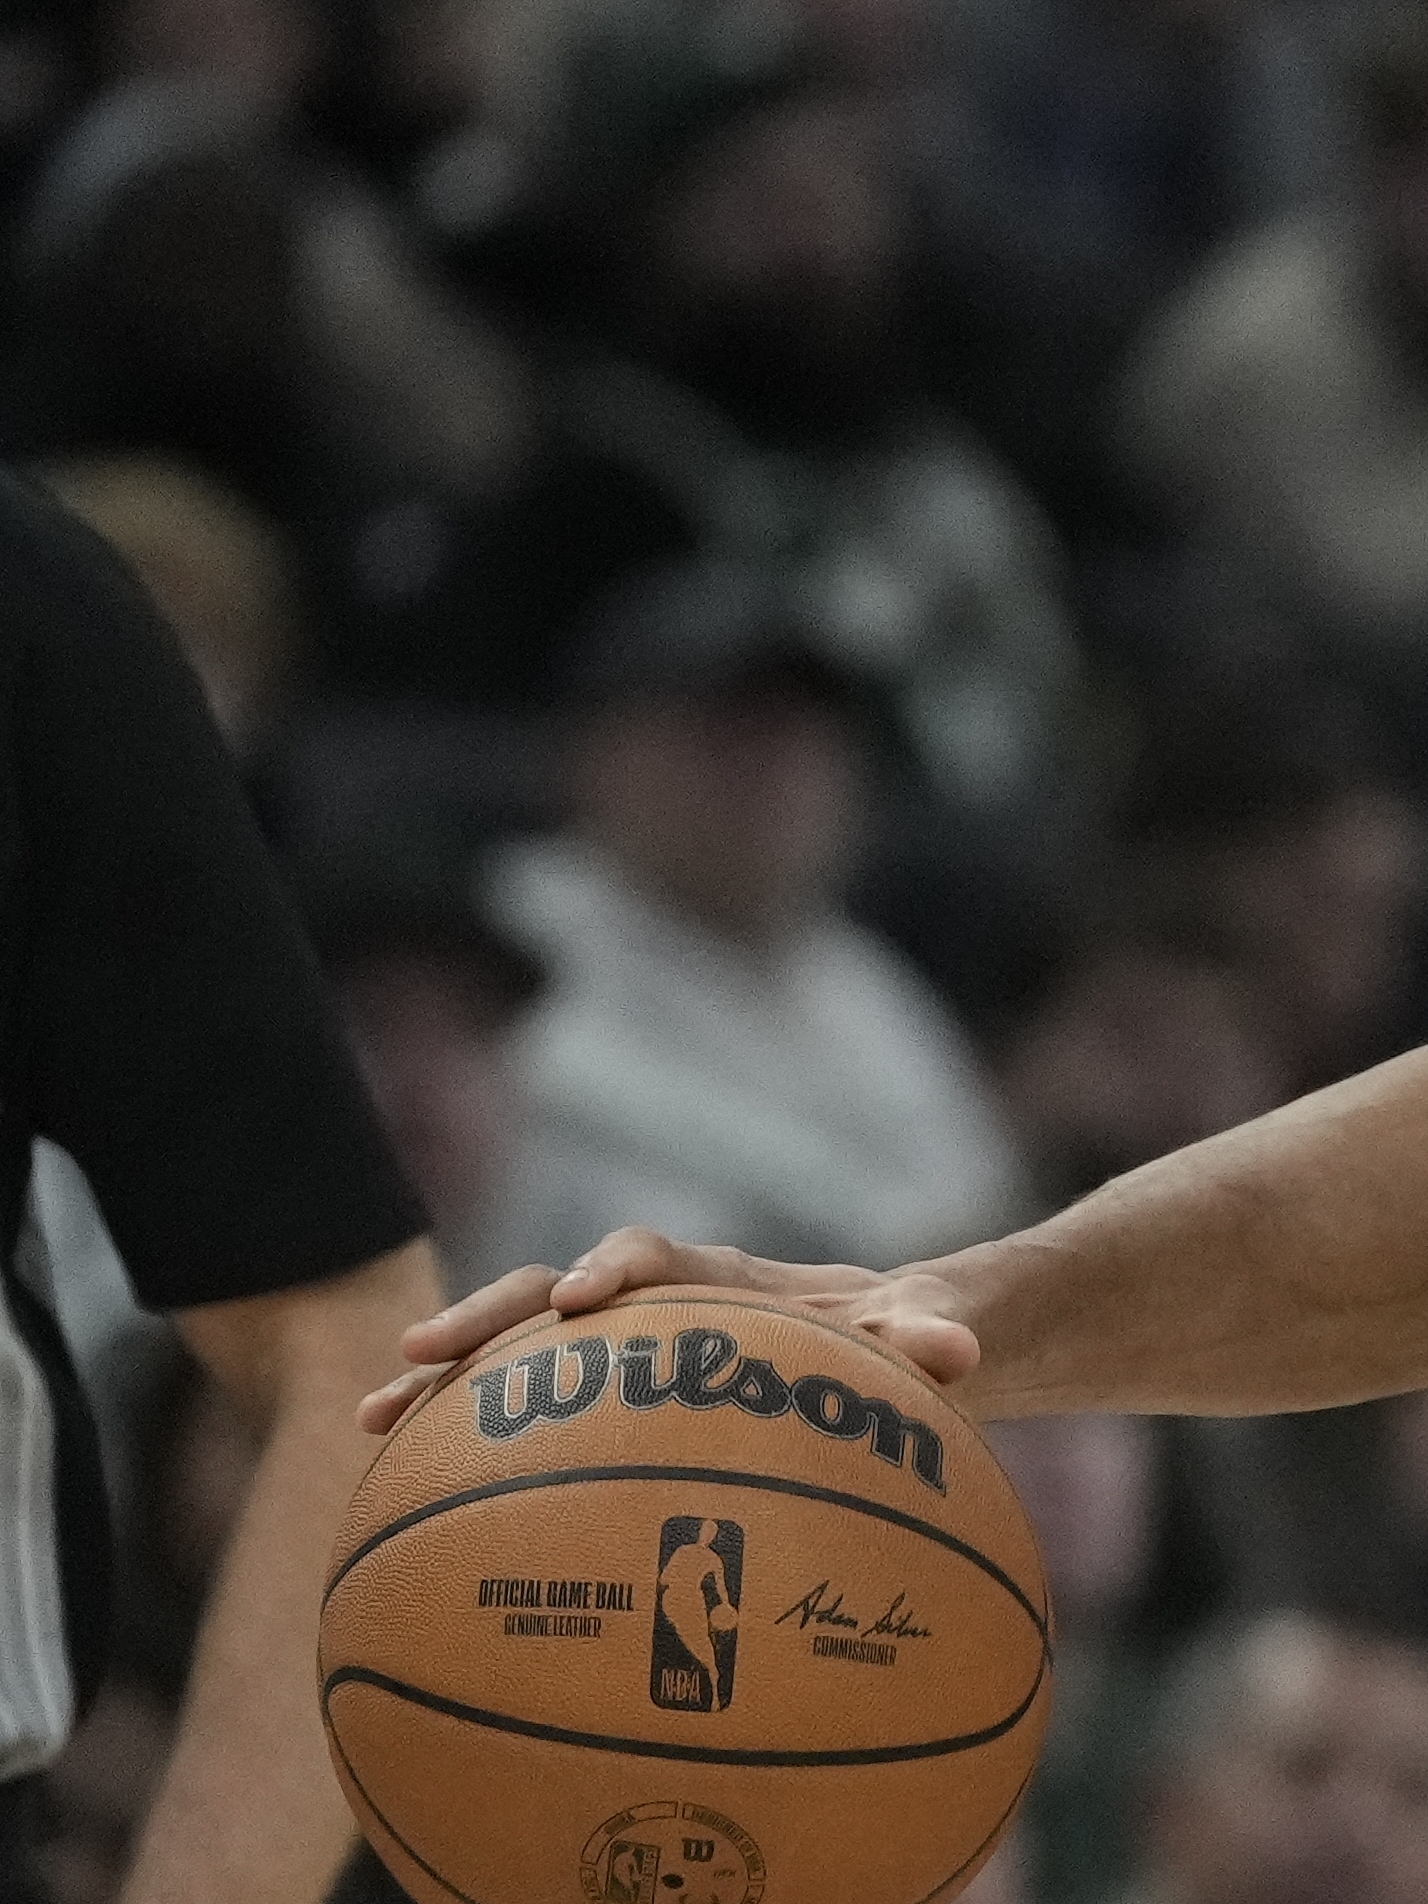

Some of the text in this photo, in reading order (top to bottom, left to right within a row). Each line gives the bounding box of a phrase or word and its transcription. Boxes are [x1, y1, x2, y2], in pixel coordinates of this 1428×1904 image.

[467, 1327, 947, 1498] Wilson
[478, 1578, 635, 1612] OFFICIAL GAME BALL
[504, 1612, 602, 1639] GENUINE LEATHER
[812, 1635, 898, 1667] COMMISSIONER
